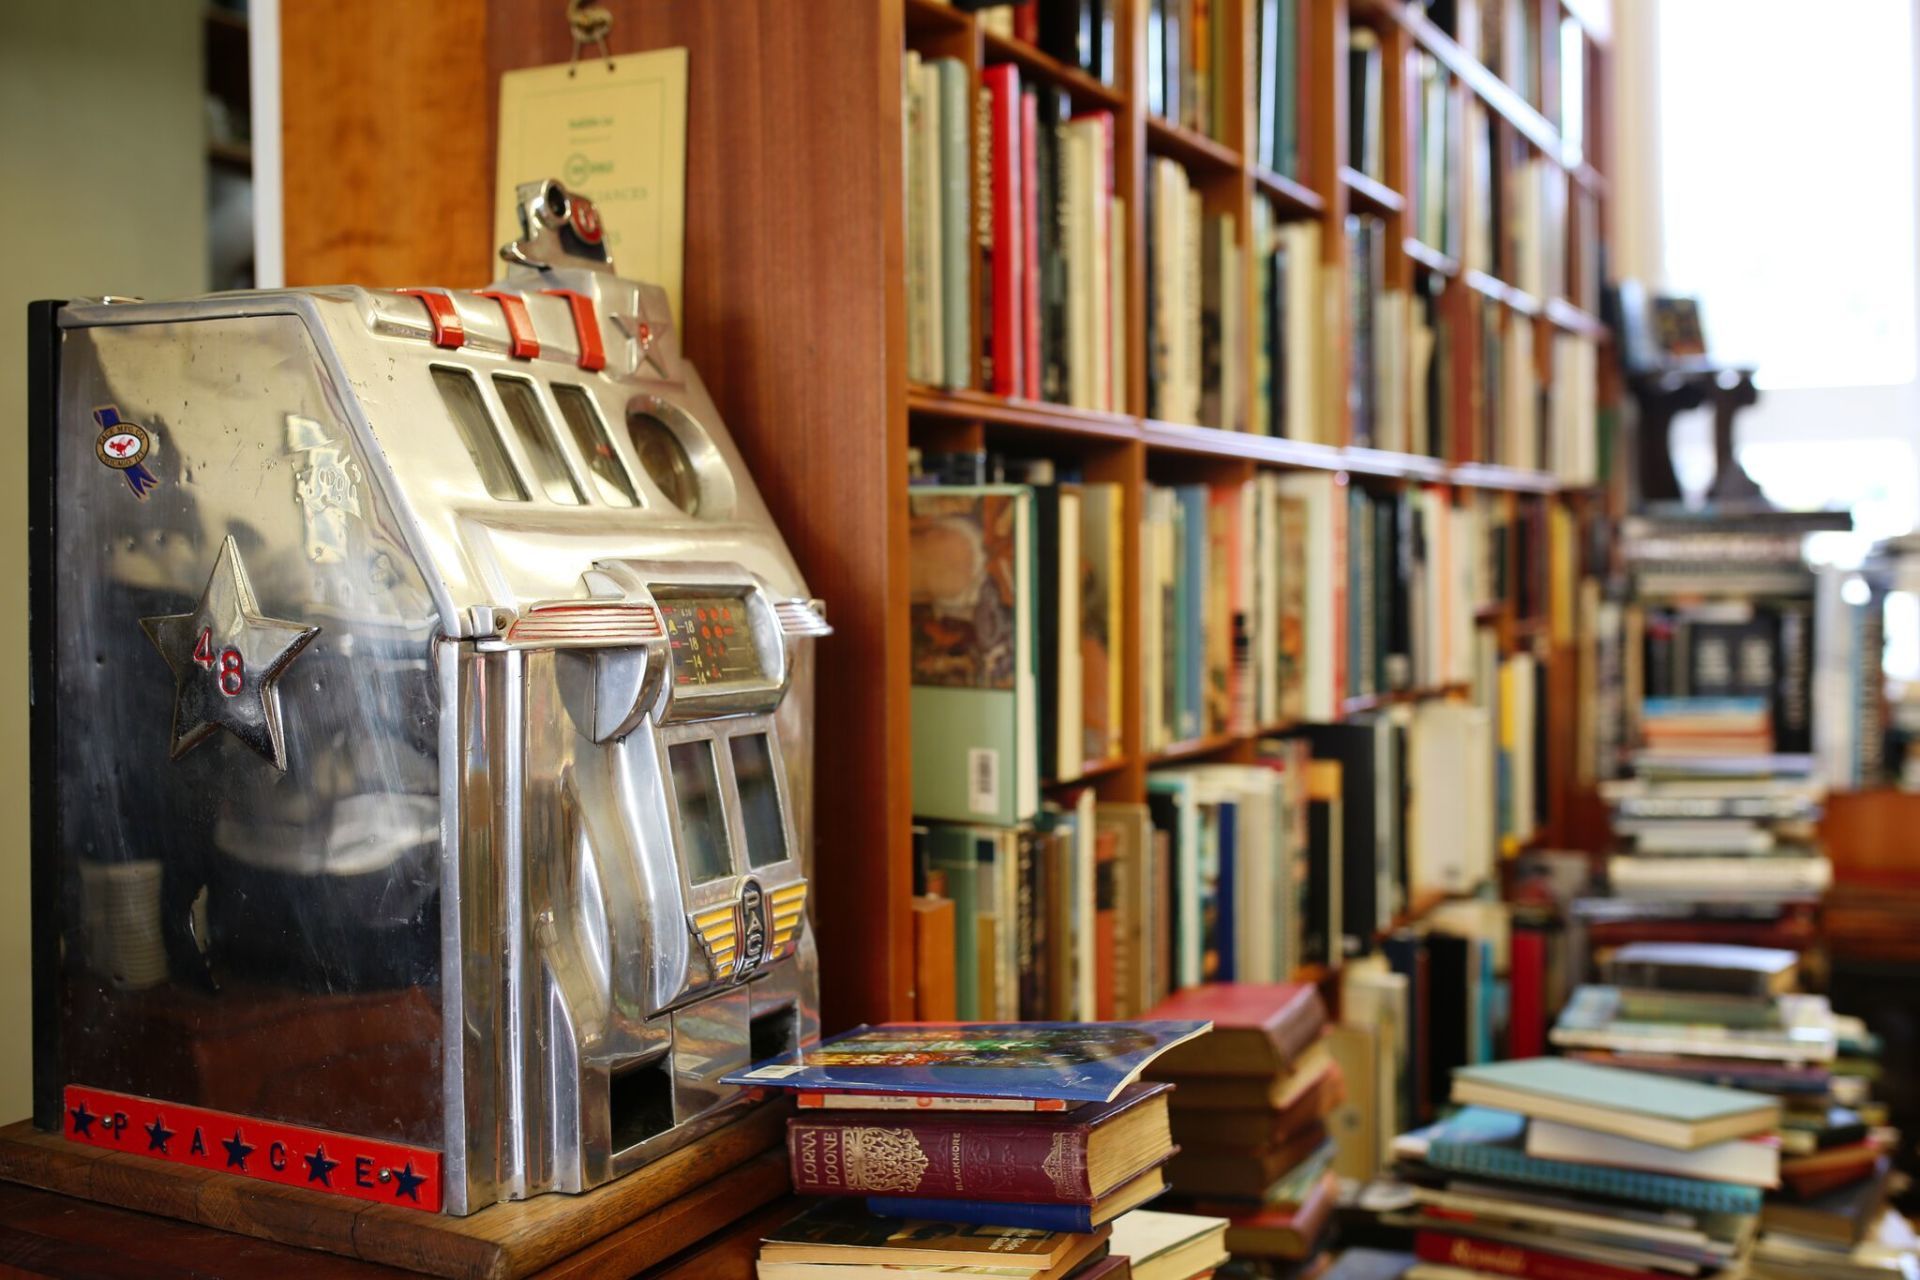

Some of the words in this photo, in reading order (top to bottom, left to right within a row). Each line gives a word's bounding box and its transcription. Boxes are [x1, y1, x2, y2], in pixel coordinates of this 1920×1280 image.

[193, 625, 243, 697] 48
[802, 1130, 818, 1184] LORNA
[823, 1132, 840, 1185] DOONE
[951, 1132, 963, 1191] BLACKMORE
